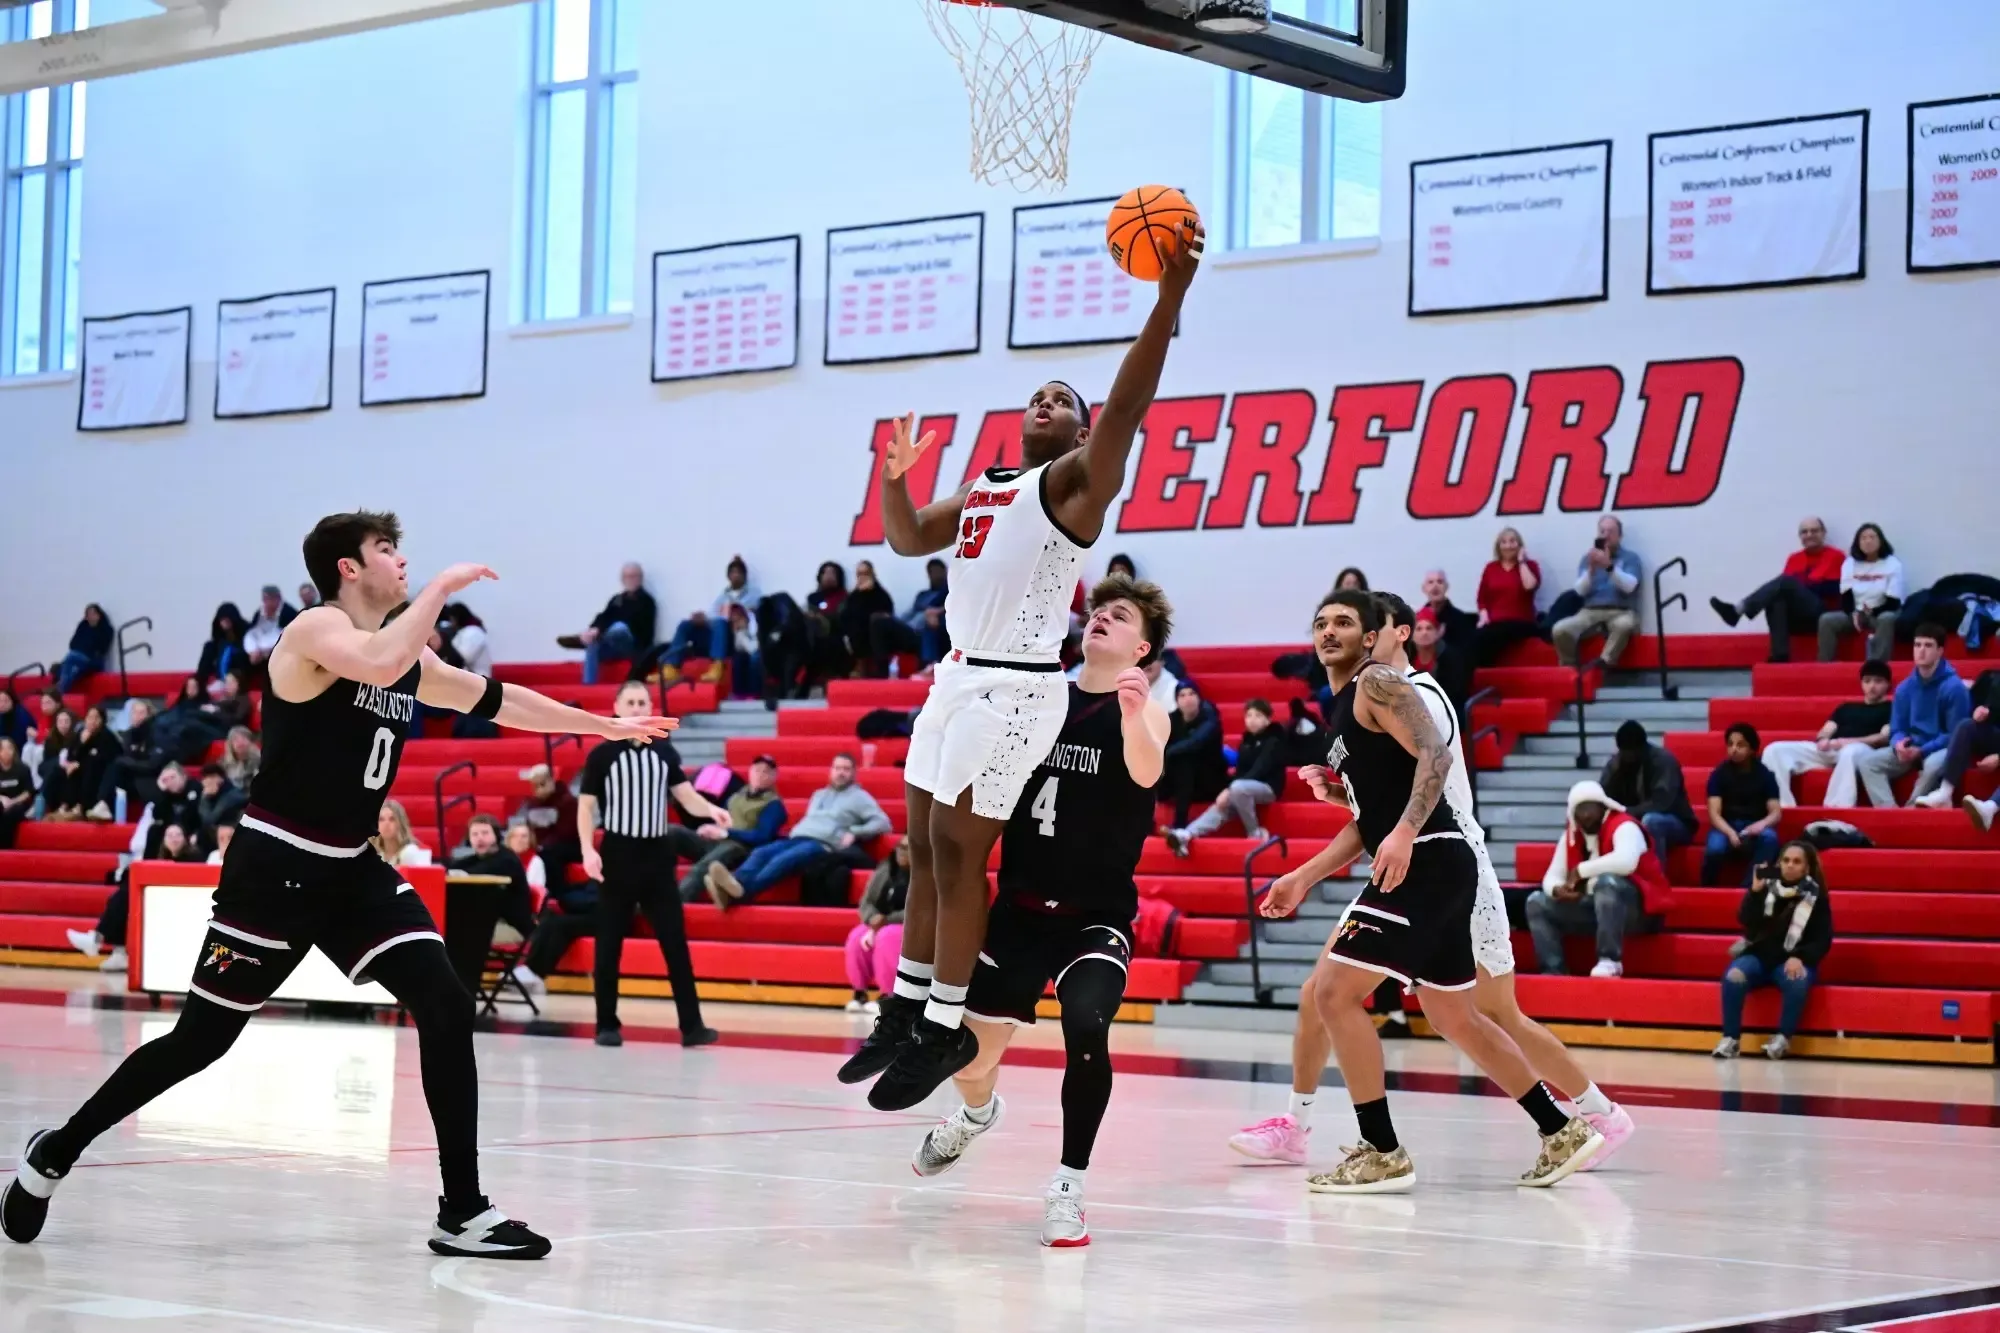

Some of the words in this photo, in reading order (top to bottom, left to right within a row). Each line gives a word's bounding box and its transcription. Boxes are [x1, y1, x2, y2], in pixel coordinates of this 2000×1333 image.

[1920, 118, 1984, 138] Centennial
[1660, 148, 1718, 166] Centennial
[1723, 143, 1786, 161] Conference
[1790, 134, 1855, 153] Champions
[1939, 149, 1988, 166] Women's
[1681, 177, 1726, 192] Women's
[1730, 174, 1763, 188] Indoor
[1766, 169, 1792, 183] Track
[1807, 166, 1831, 178] Field
[1971, 168, 1998, 182] 2009
[1931, 207, 1958, 219] 2007
[363, 726, 396, 791] 0
[1031, 776, 1059, 837] 4
